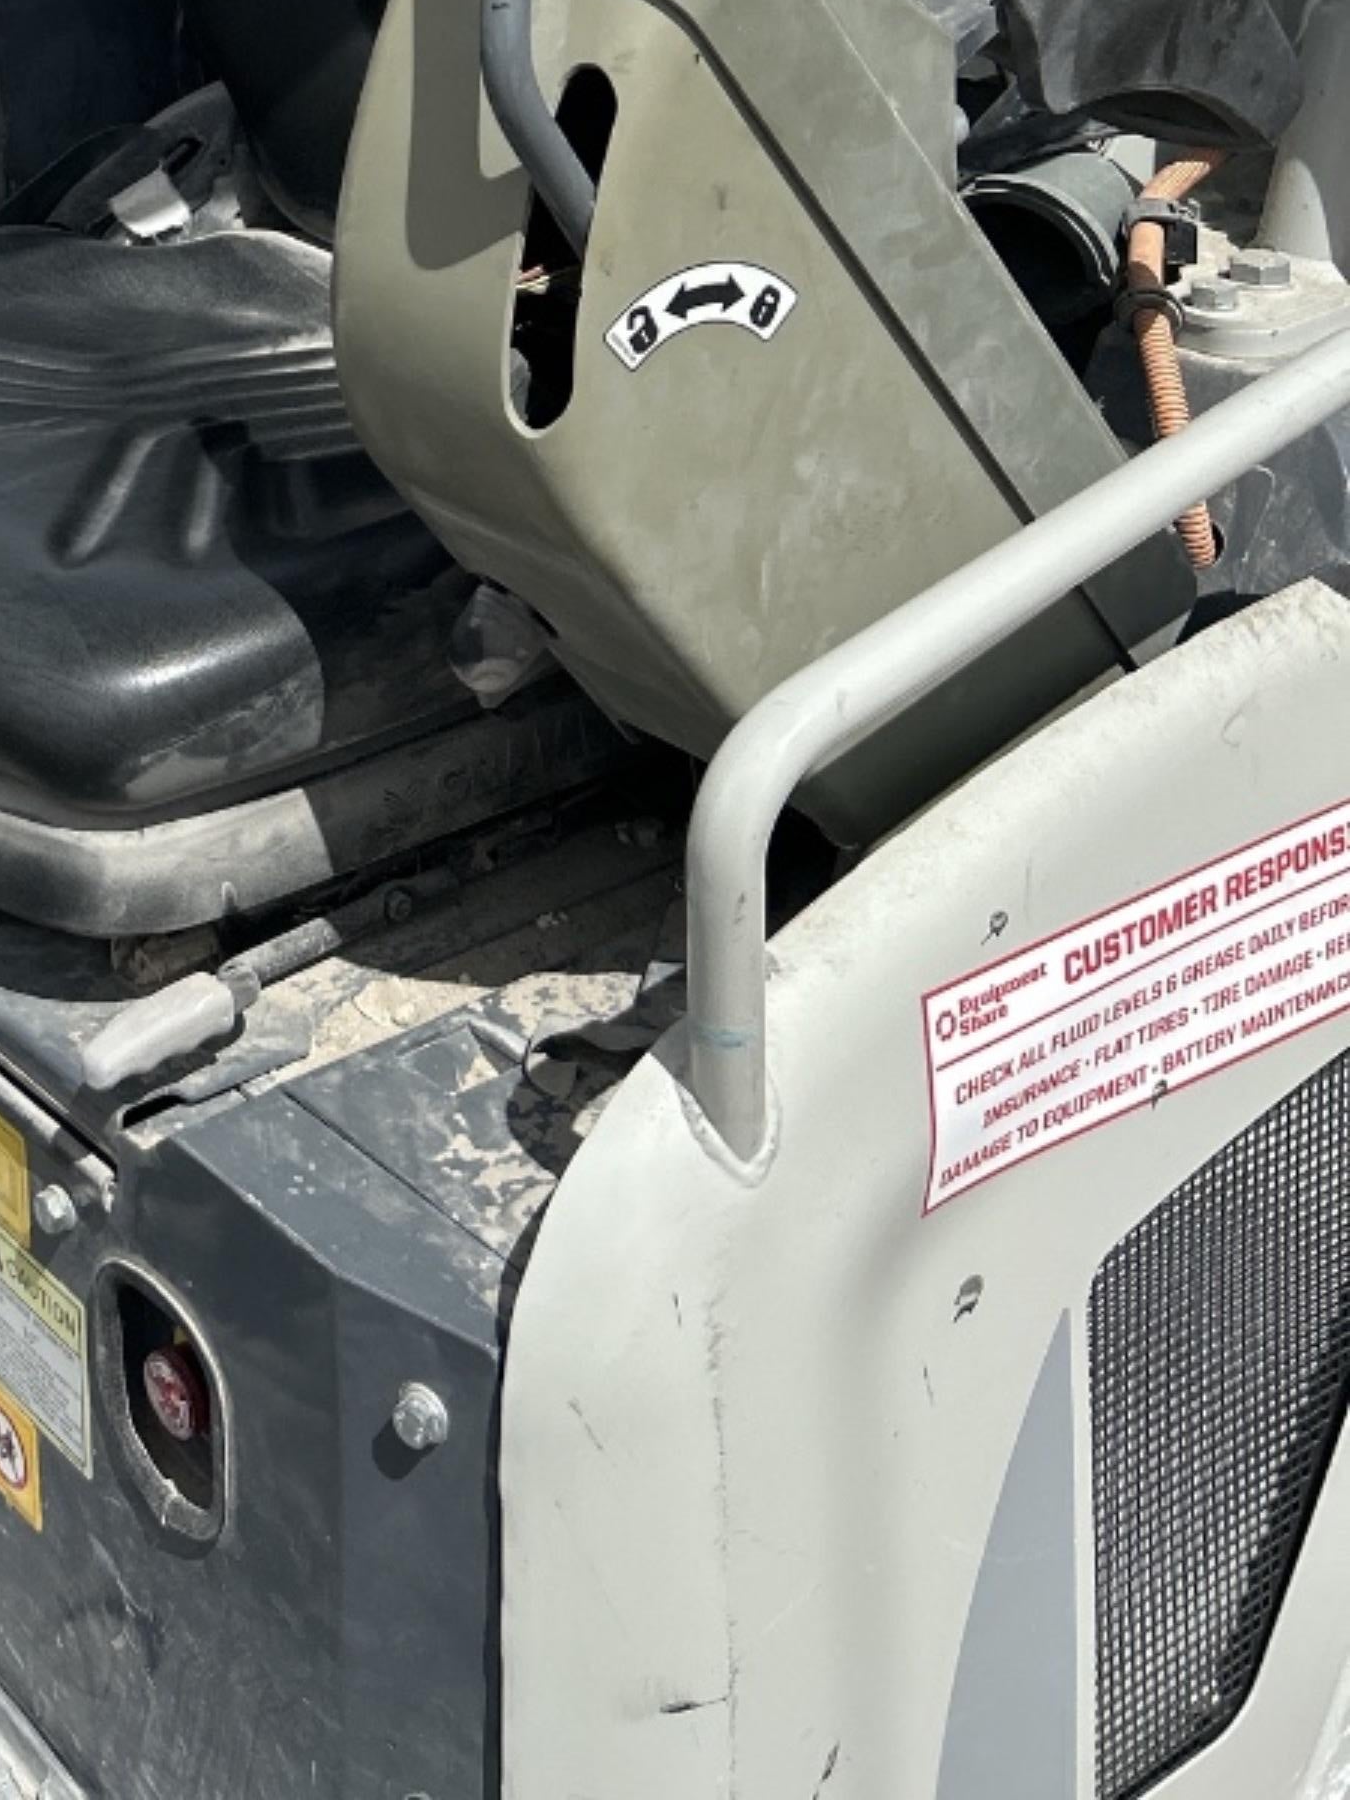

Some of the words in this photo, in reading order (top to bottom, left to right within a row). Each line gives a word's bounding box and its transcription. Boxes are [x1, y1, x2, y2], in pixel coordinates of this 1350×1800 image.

[956, 1057, 1015, 1105] CHECK
[1017, 1041, 1049, 1073] ALL
[1051, 1013, 1100, 1055] FLUID
[1103, 982, 1163, 1028] LEVELS
[1181, 941, 1245, 988] GREASE
[1250, 918, 1295, 955] DAILY
[1063, 883, 1218, 985] CUSTOMER
[939, 1127, 1012, 1189] DAMAGE
[1017, 1117, 1039, 1144] TO
[1043, 1064, 1150, 1132] EQUIPMENT
[1162, 1025, 1236, 1076] BATTERY
[983, 1060, 1082, 1128] INSURANCE
[1094, 1031, 1133, 1070] FLAT
[1138, 1006, 1189, 1046] TIRES
[1200, 979, 1241, 1016] TIRE
[1245, 949, 1313, 997] DAMAGE
